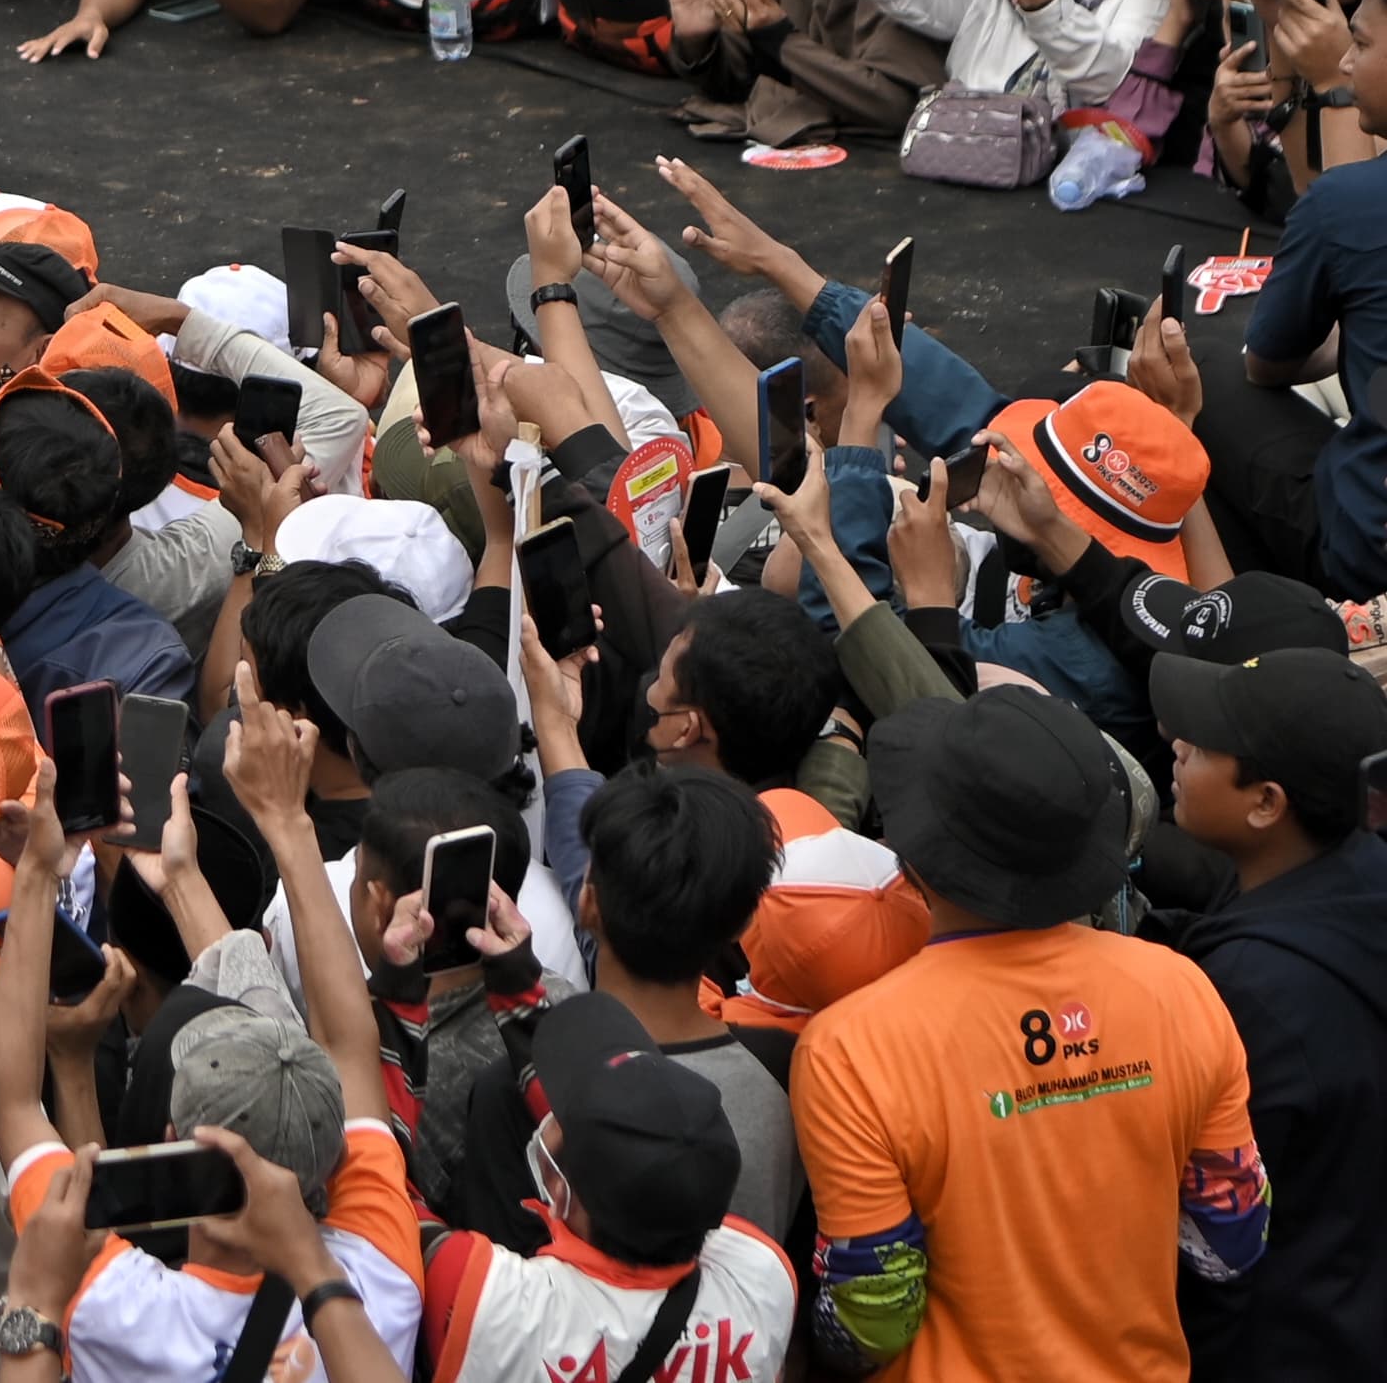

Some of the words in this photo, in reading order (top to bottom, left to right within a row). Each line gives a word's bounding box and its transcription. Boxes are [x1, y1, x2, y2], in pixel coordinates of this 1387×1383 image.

[1096, 464, 1115, 483] PKS
[1020, 1009, 1056, 1066] 8
[1063, 1038, 1100, 1061] PKS
[1037, 1071, 1099, 1095] MUHAMMAD
[1101, 1060, 1152, 1081] MUSTAFA
